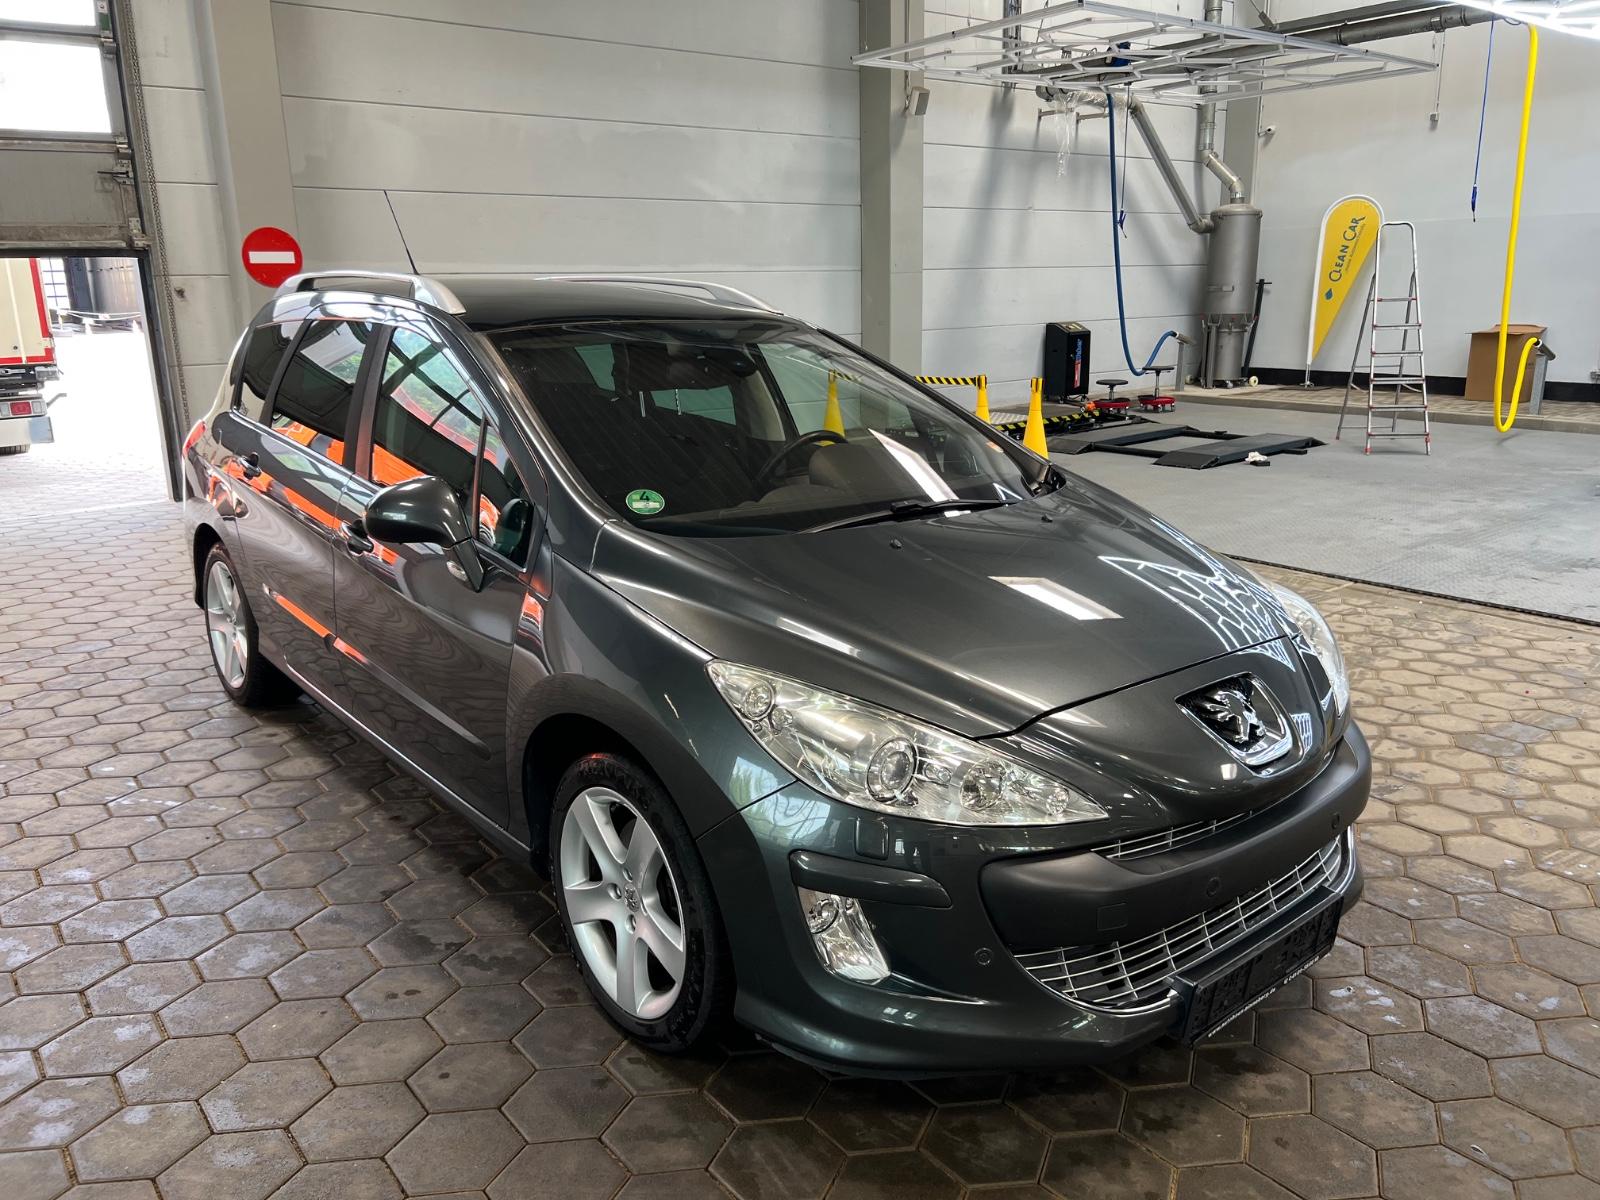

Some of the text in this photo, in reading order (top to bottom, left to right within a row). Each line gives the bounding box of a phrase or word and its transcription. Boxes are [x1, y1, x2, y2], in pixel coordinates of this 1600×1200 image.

[1328, 245, 1349, 282] CLEAN
[1343, 216, 1366, 241] CAR
[640, 491, 650, 501] 4
